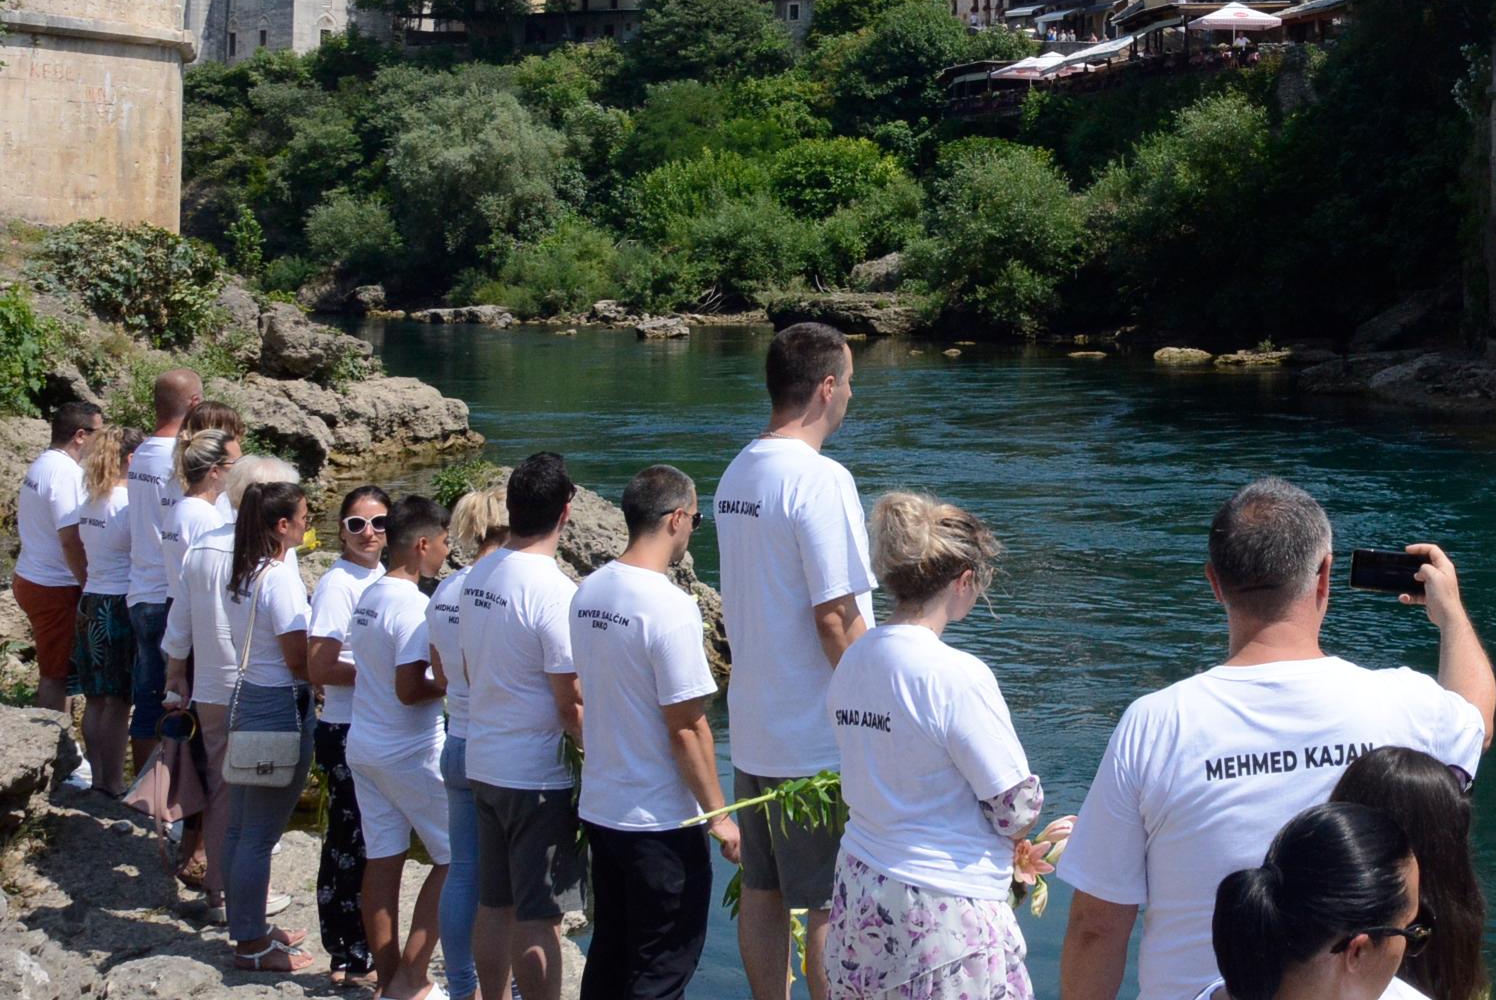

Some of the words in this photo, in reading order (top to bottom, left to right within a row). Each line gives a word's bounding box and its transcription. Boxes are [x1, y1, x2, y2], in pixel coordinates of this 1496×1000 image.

[578, 609, 601, 618] ENVER
[601, 610, 629, 627] SALČIN
[592, 619, 608, 630] ENKO
[860, 711, 891, 733] AJANIĆ
[1205, 750, 1298, 781] MEHMED
